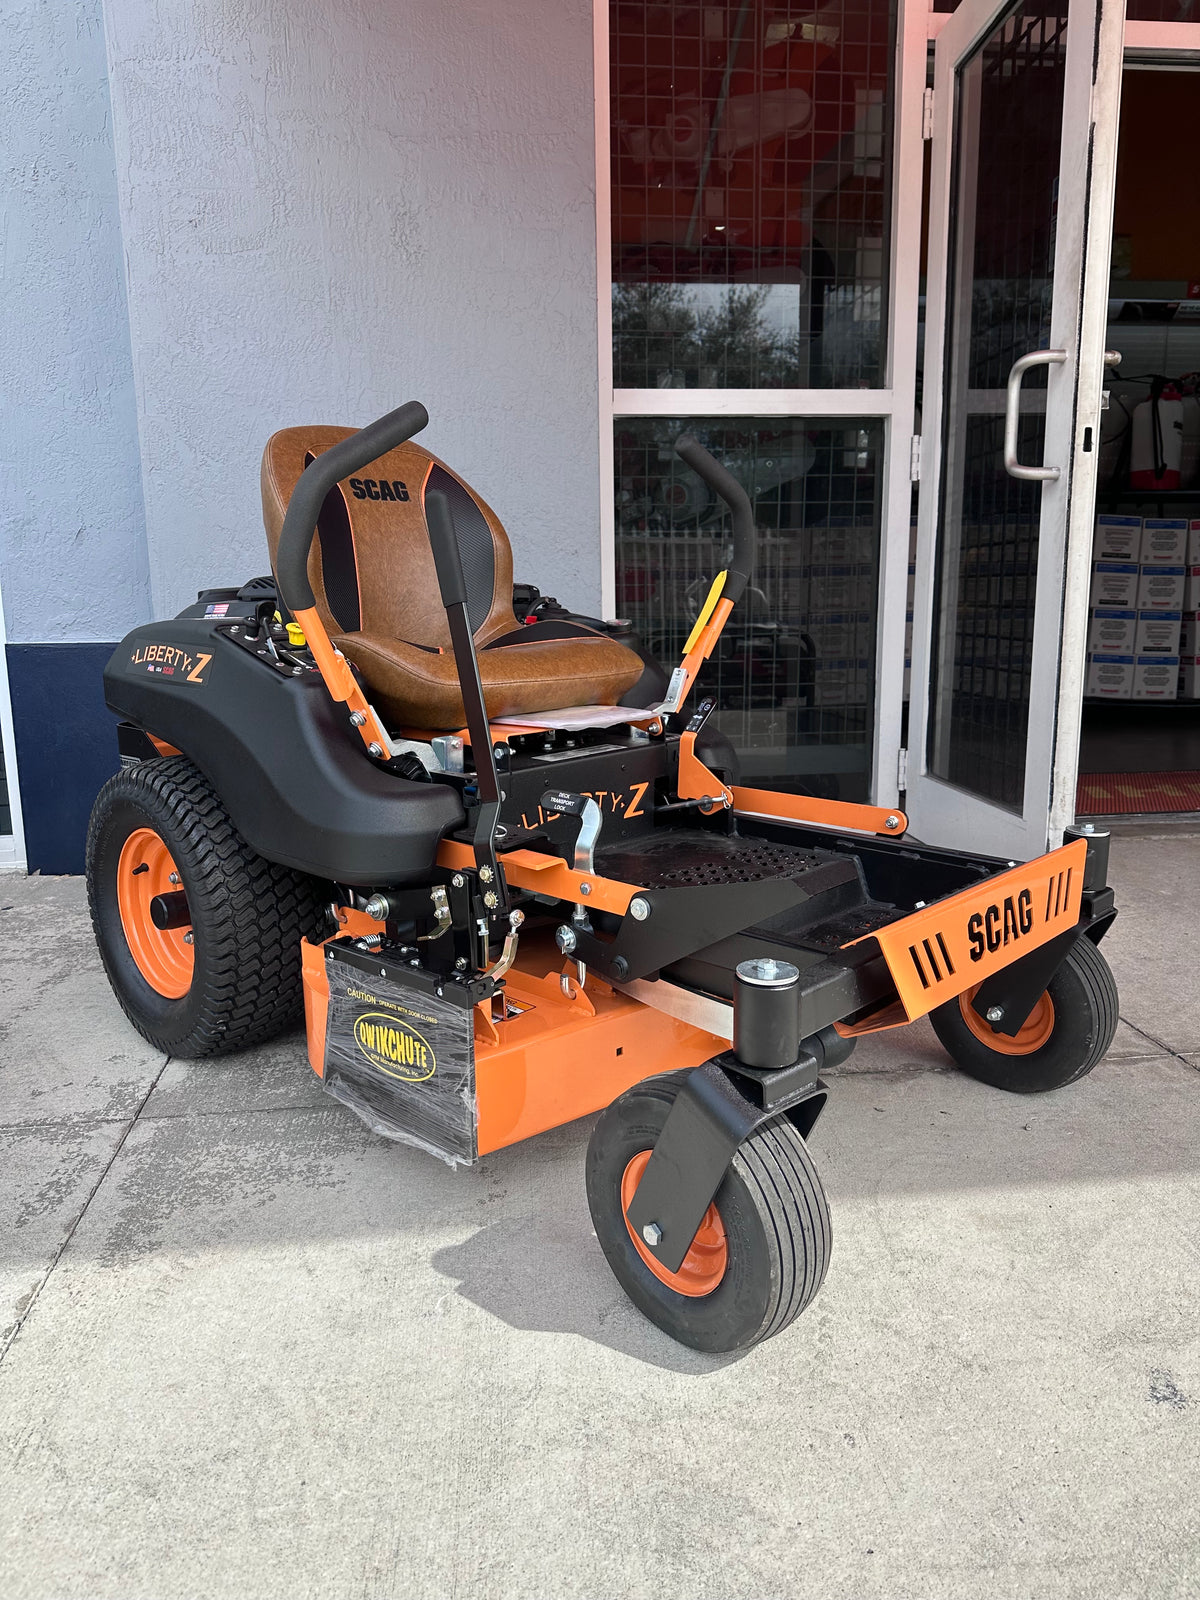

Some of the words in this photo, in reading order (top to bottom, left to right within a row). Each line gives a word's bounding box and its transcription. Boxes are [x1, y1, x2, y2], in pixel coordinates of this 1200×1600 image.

[349, 478, 410, 502] SCAG
[134, 645, 192, 672] LIBERTY
[186, 653, 213, 683] Z
[550, 796, 575, 807] TRANSPORT
[623, 781, 650, 819] Z
[967, 888, 1034, 963] SCAG
[347, 987, 376, 1005] CAUTION
[379, 1000, 397, 1011] OPERATE
[397, 1006, 408, 1015] WITH
[420, 1014, 439, 1024] CLOSED
[360, 1021, 428, 1068] QWIKCHUTE
